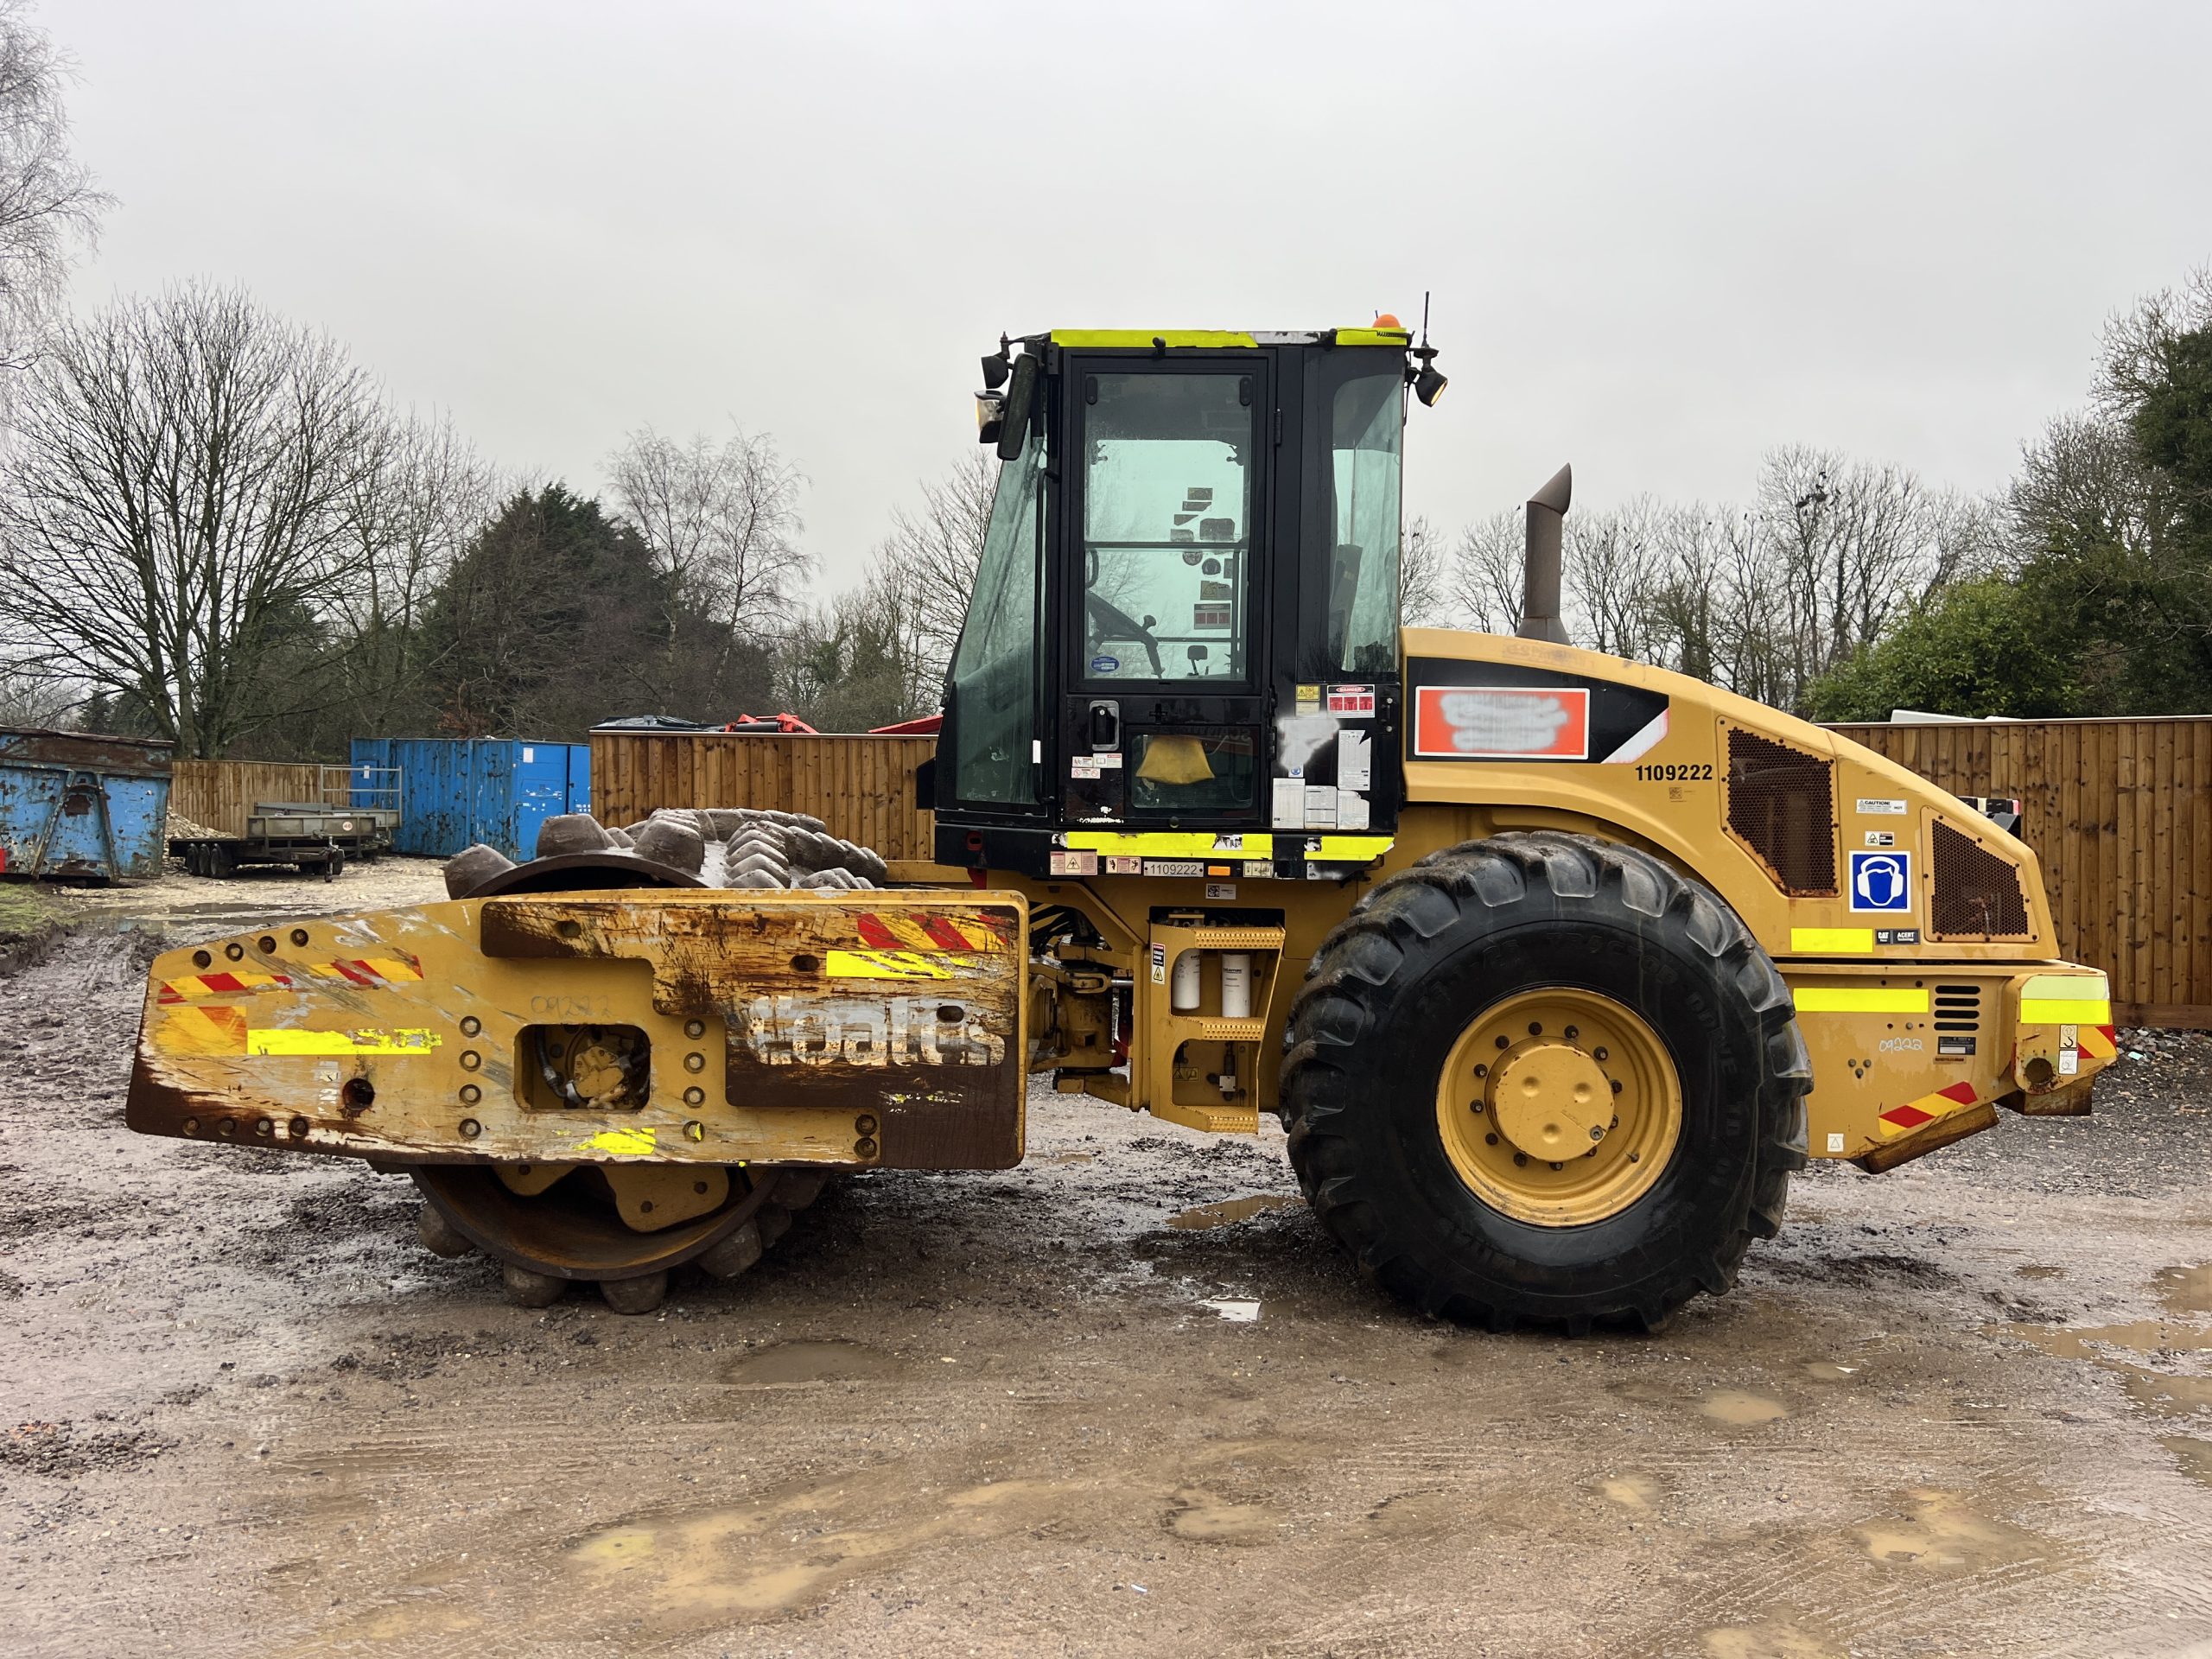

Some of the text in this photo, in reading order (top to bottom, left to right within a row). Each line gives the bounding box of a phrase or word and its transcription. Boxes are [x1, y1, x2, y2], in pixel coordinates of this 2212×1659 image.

[1635, 764, 1713, 781] 1109222
[1150, 864, 1198, 875] 1109222
[1878, 1037, 1923, 1054] 09222
